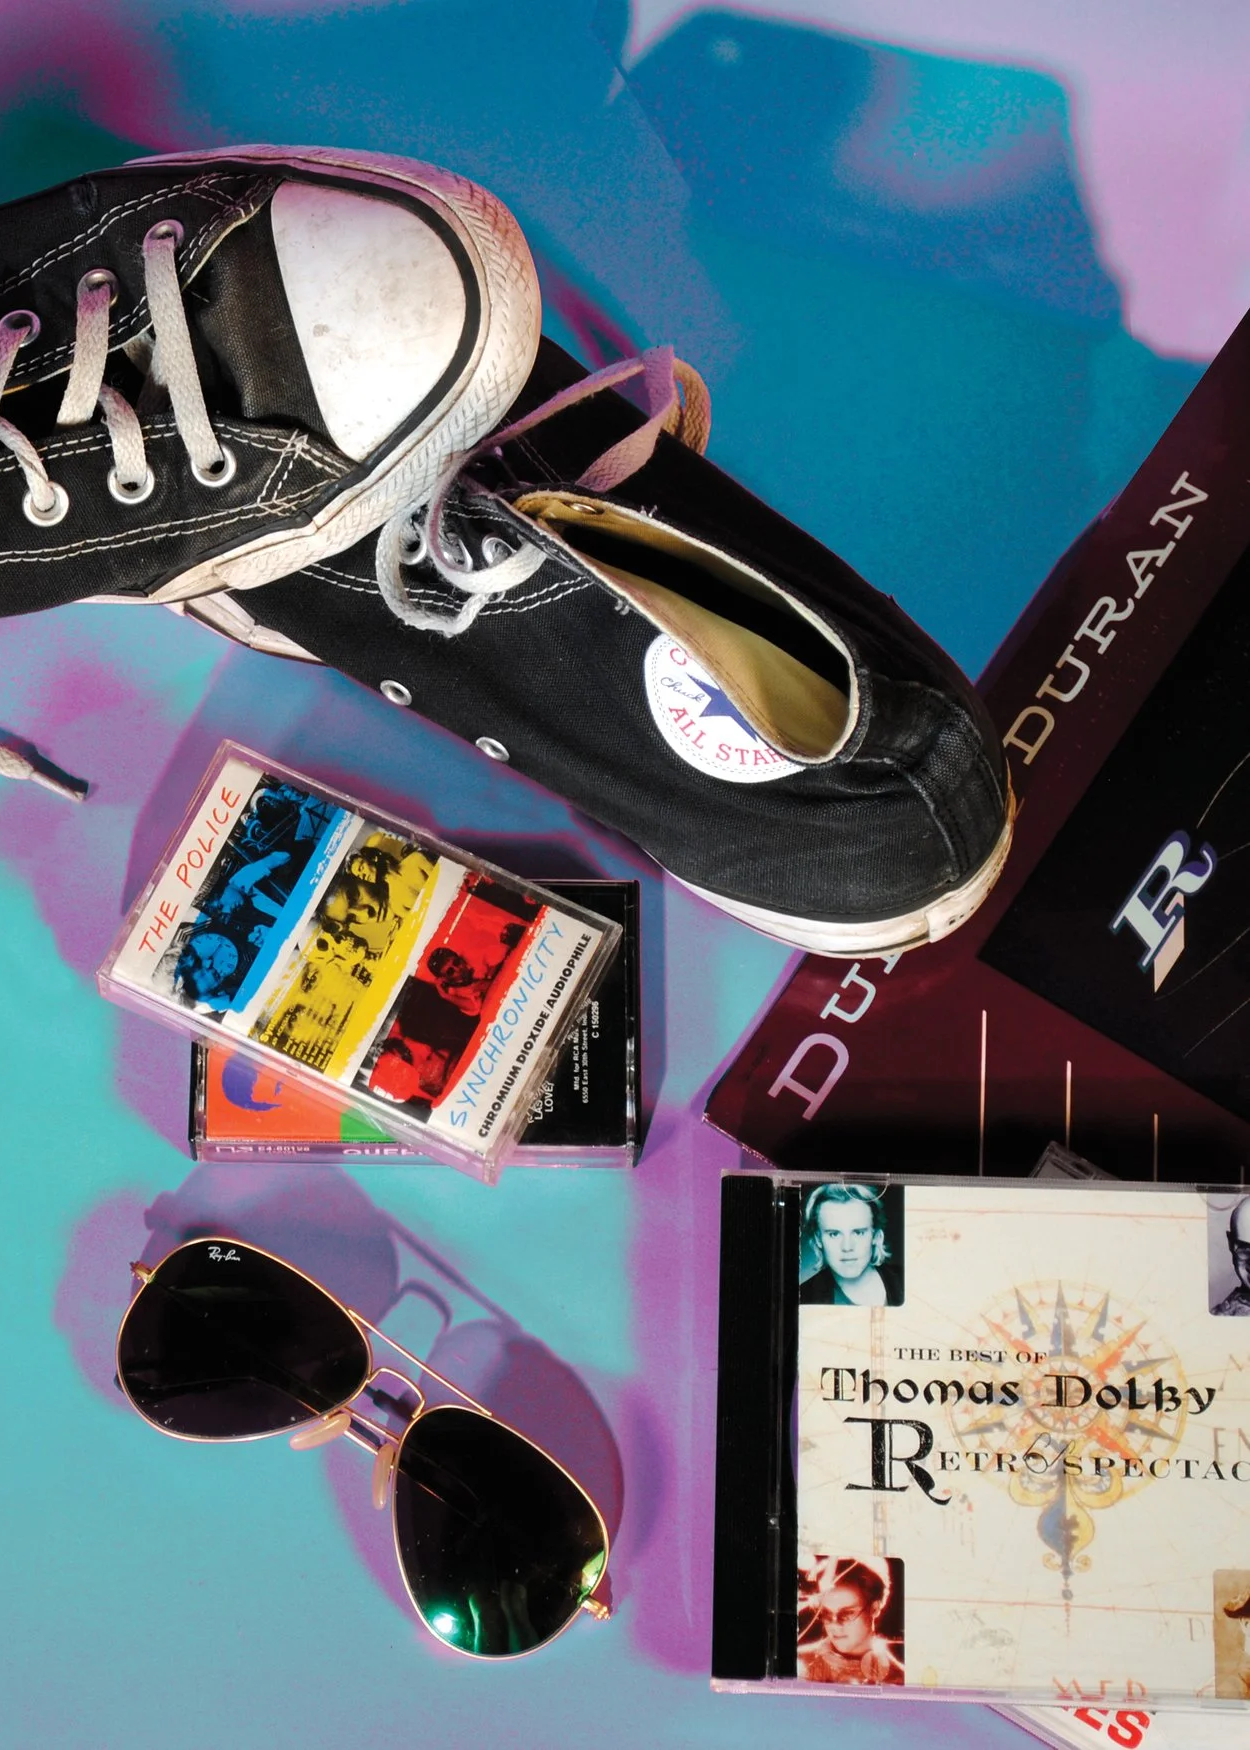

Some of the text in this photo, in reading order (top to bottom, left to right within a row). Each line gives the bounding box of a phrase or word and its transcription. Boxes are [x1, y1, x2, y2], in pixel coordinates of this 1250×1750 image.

[1002, 471, 1209, 766] DURAN
[660, 677, 702, 703] Chuck
[669, 707, 787, 766] ALL STAR
[137, 784, 241, 954] THE POLICE
[450, 921, 563, 1128] SYNCHRONICITY
[477, 1064, 521, 1138] CHROMIUM
[207, 1246, 241, 1262] Ray-Ban
[893, 1348, 1048, 1364] THE BEST OF
[820, 1366, 1021, 1407] Thomas
